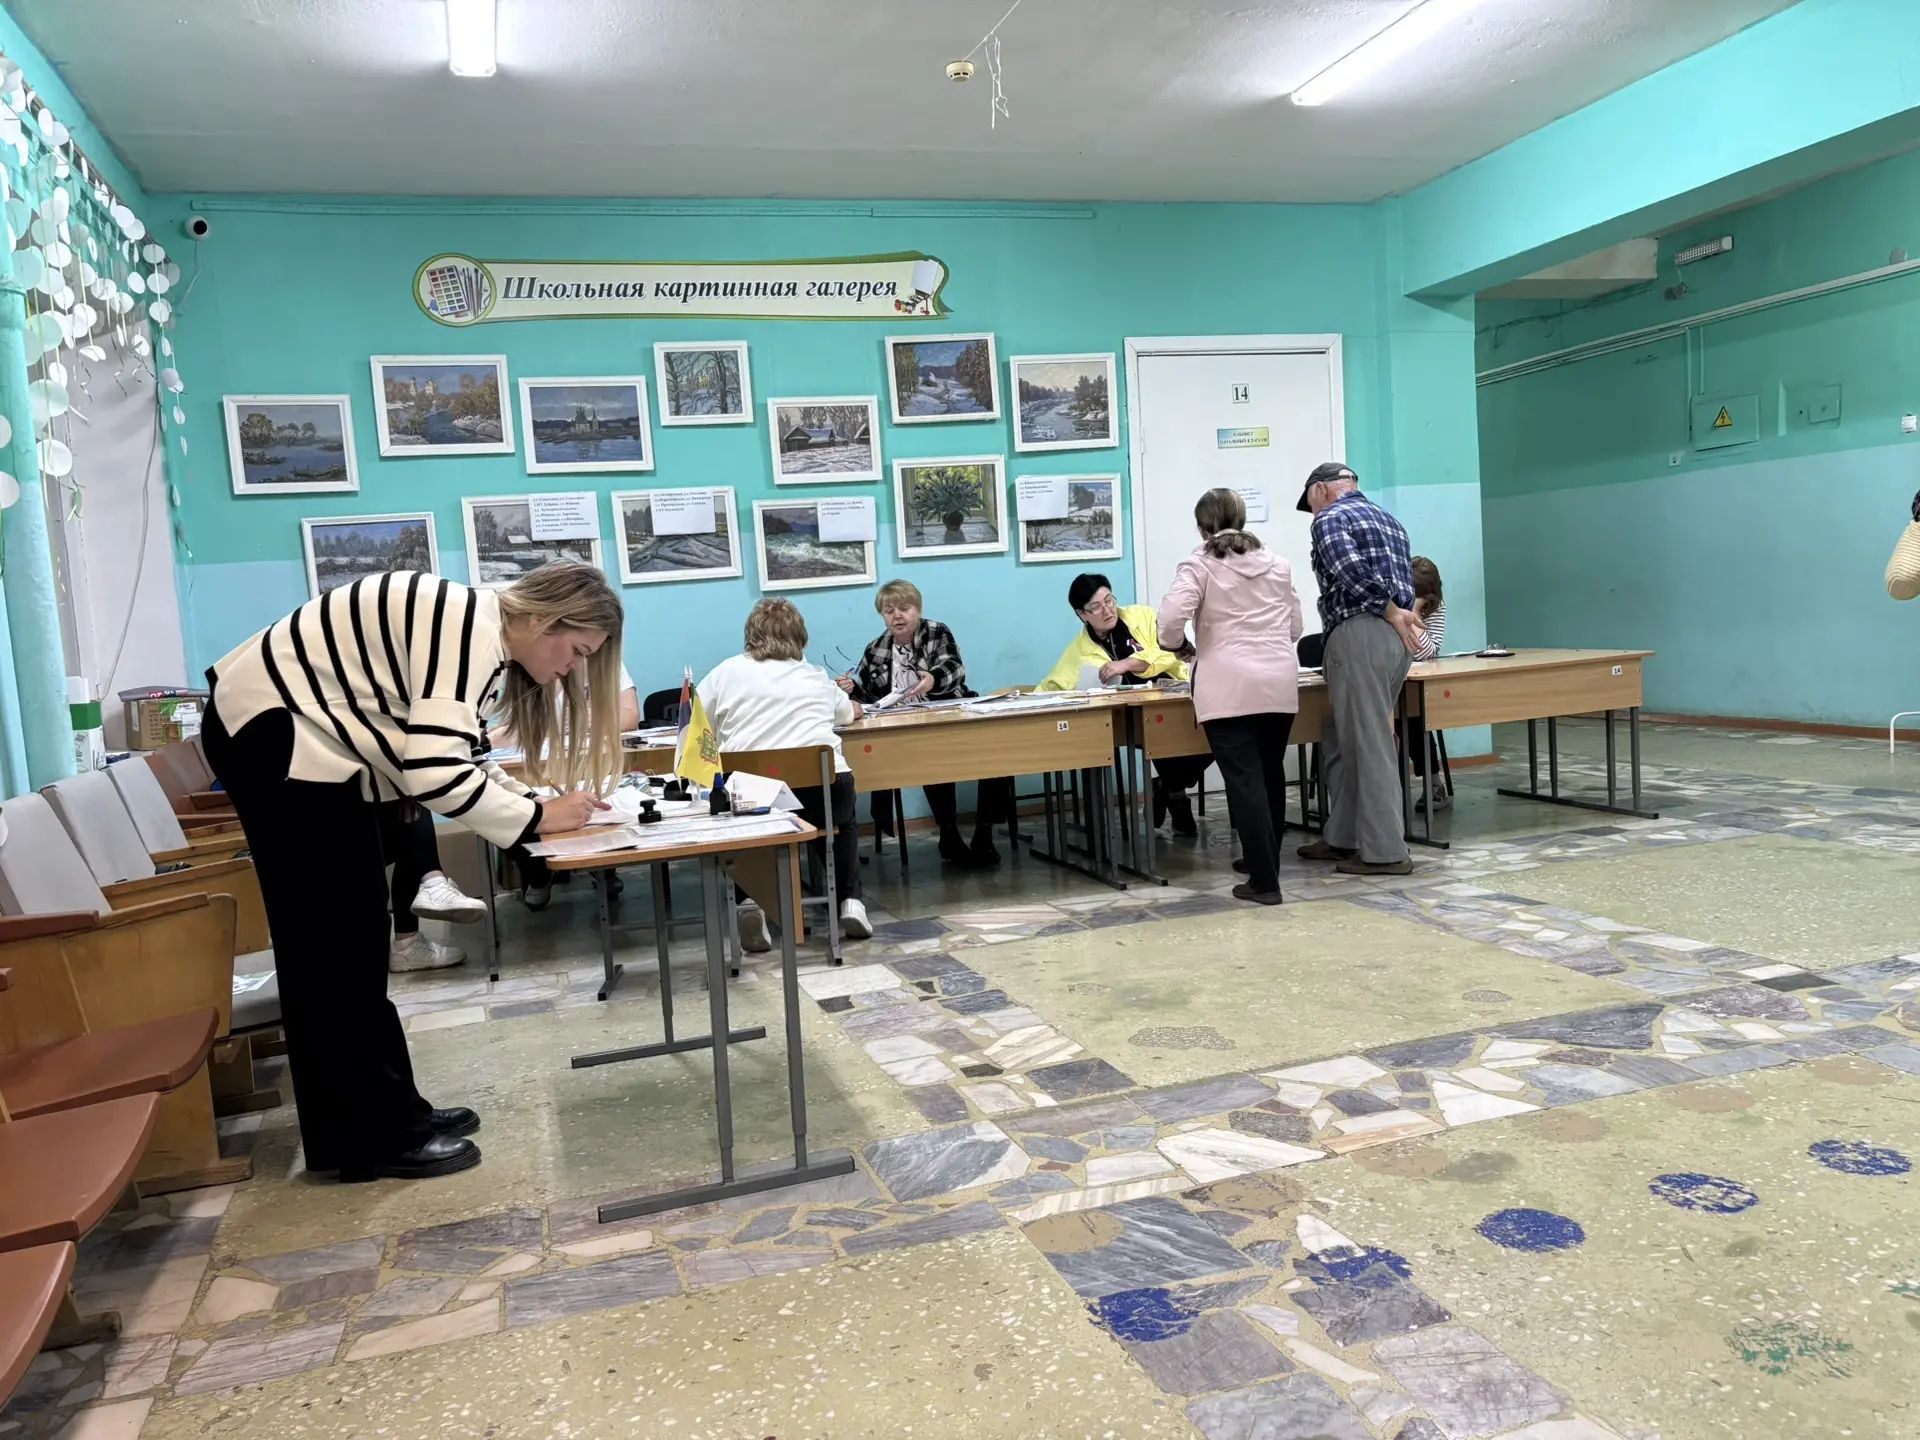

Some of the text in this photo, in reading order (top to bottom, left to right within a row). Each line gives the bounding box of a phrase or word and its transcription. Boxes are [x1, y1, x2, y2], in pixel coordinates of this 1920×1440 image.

[502, 276, 898, 304] Школьная картинная галерея
[1234, 387, 1248, 400] 14
[1059, 722, 1067, 730] 14
